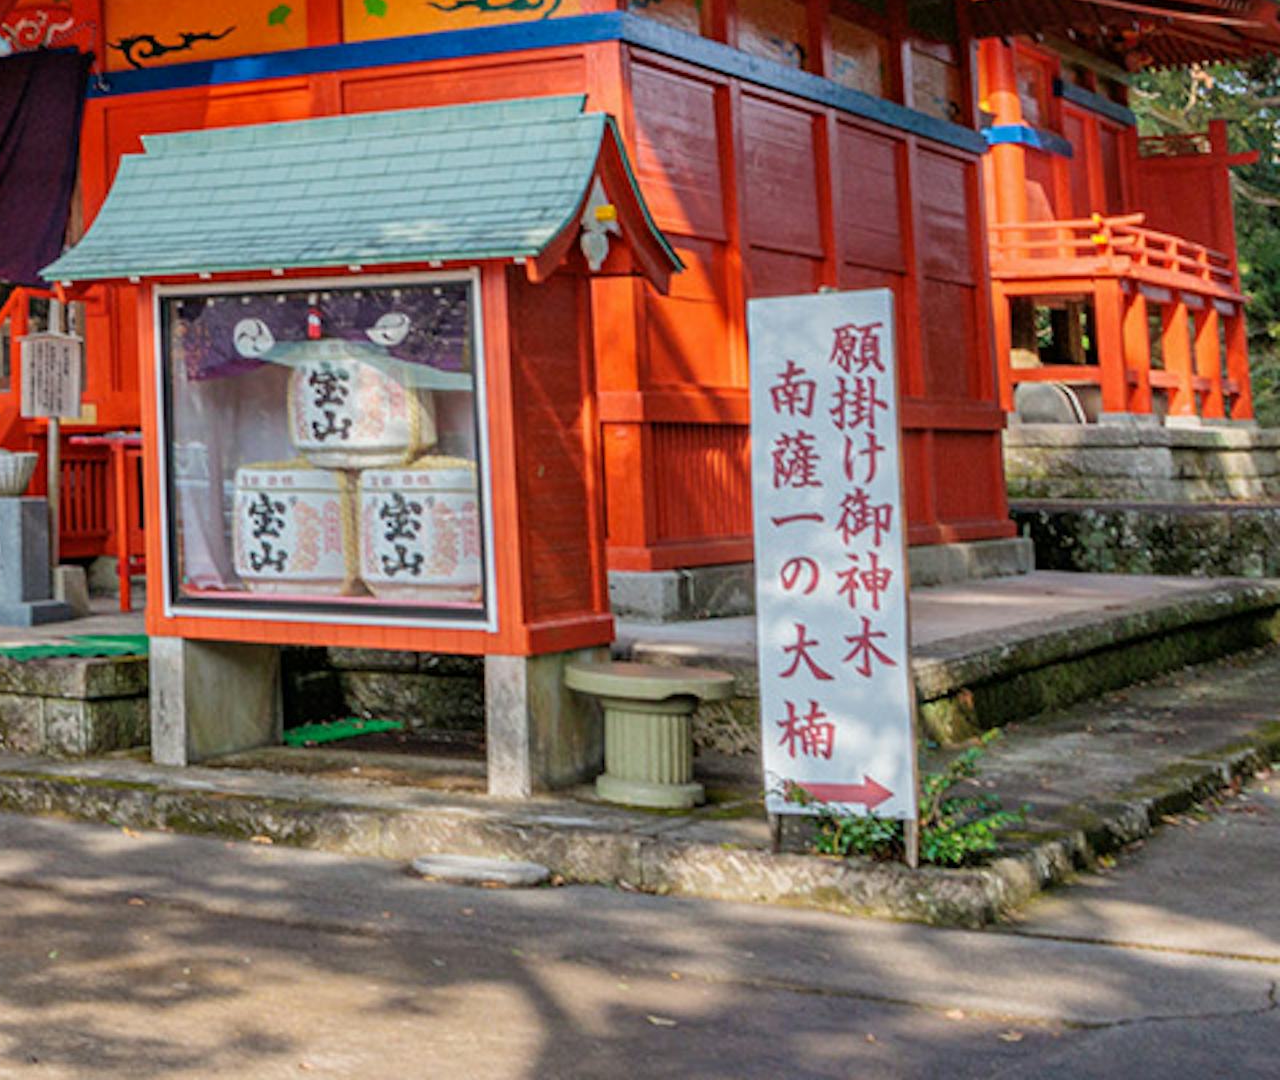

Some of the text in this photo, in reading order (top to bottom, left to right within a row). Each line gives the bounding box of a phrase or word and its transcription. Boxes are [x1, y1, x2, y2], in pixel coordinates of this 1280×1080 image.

[309, 361, 353, 442] 宝山
[248, 492, 289, 573] 宝山
[379, 492, 425, 577] 宝山
[829, 320, 899, 678] 願掛け御神木
[769, 359, 836, 761] 南薩一の大楠
